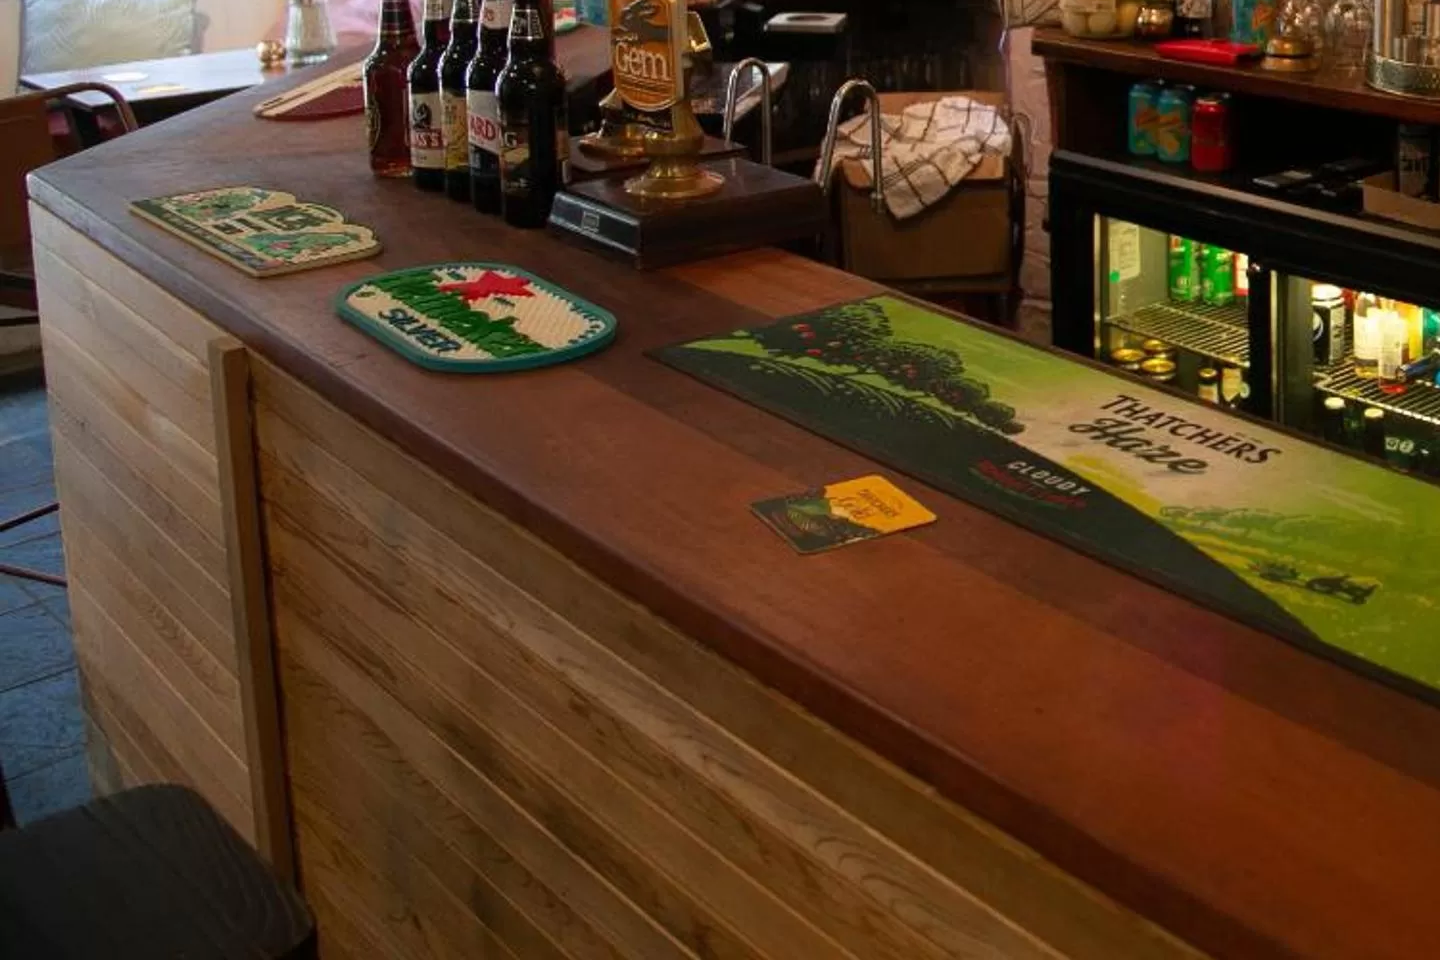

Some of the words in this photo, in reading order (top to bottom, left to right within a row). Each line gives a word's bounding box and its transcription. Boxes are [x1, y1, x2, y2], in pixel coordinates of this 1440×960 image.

[615, 41, 672, 80] Gem
[379, 308, 462, 354] SILVER
[1068, 417, 1208, 474] Haze
[1101, 395, 1282, 464] THATCHERS
[1007, 461, 1091, 496] CLOUDY
